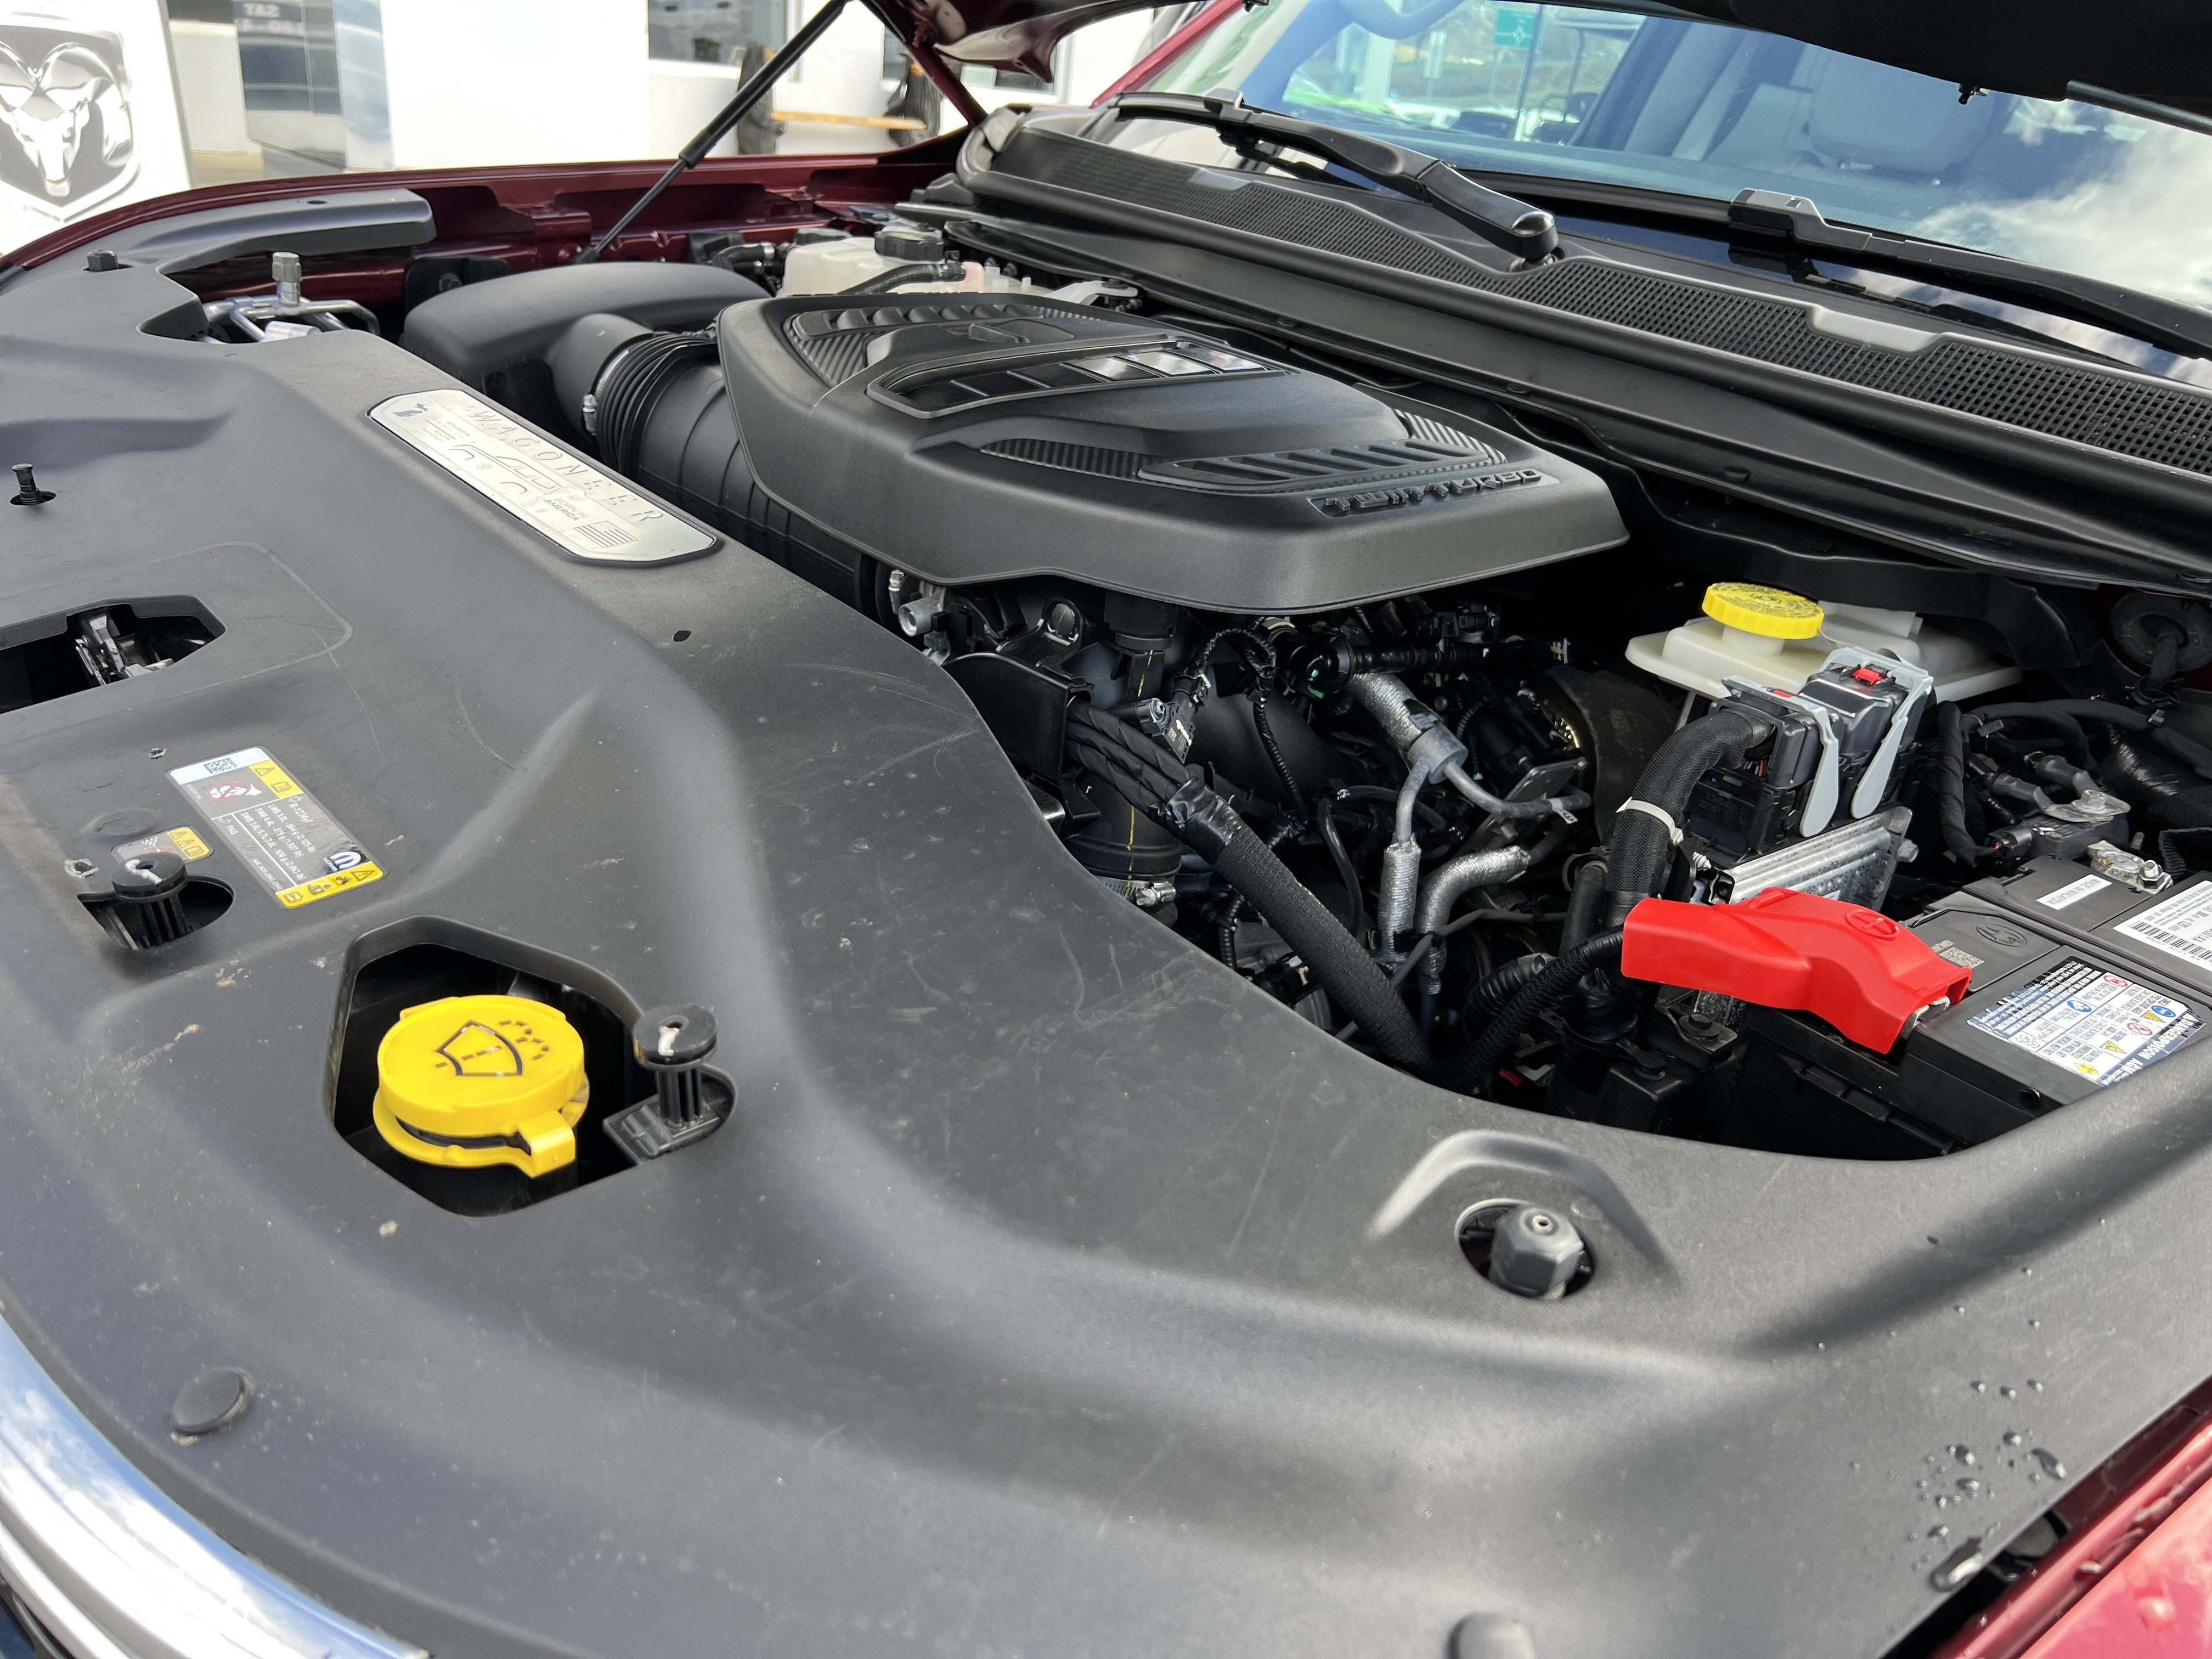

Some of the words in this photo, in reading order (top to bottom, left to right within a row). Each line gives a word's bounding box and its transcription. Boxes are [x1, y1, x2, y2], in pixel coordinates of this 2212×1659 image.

[469, 410, 663, 521] WAGONEER
[1324, 486, 1425, 511] TWIN
[1426, 468, 1542, 497] TURBO
[544, 500, 579, 521] AMERICA
[554, 498, 579, 512] BORN
[253, 808, 268, 818] SWB
[267, 804, 281, 814] LWB
[240, 811, 255, 822] SWB
[224, 825, 239, 835] PAG
[2080, 878, 2101, 889] MADE
[2046, 889, 2078, 906] MALAYSIA
[2120, 1058, 2144, 1074] AGM
